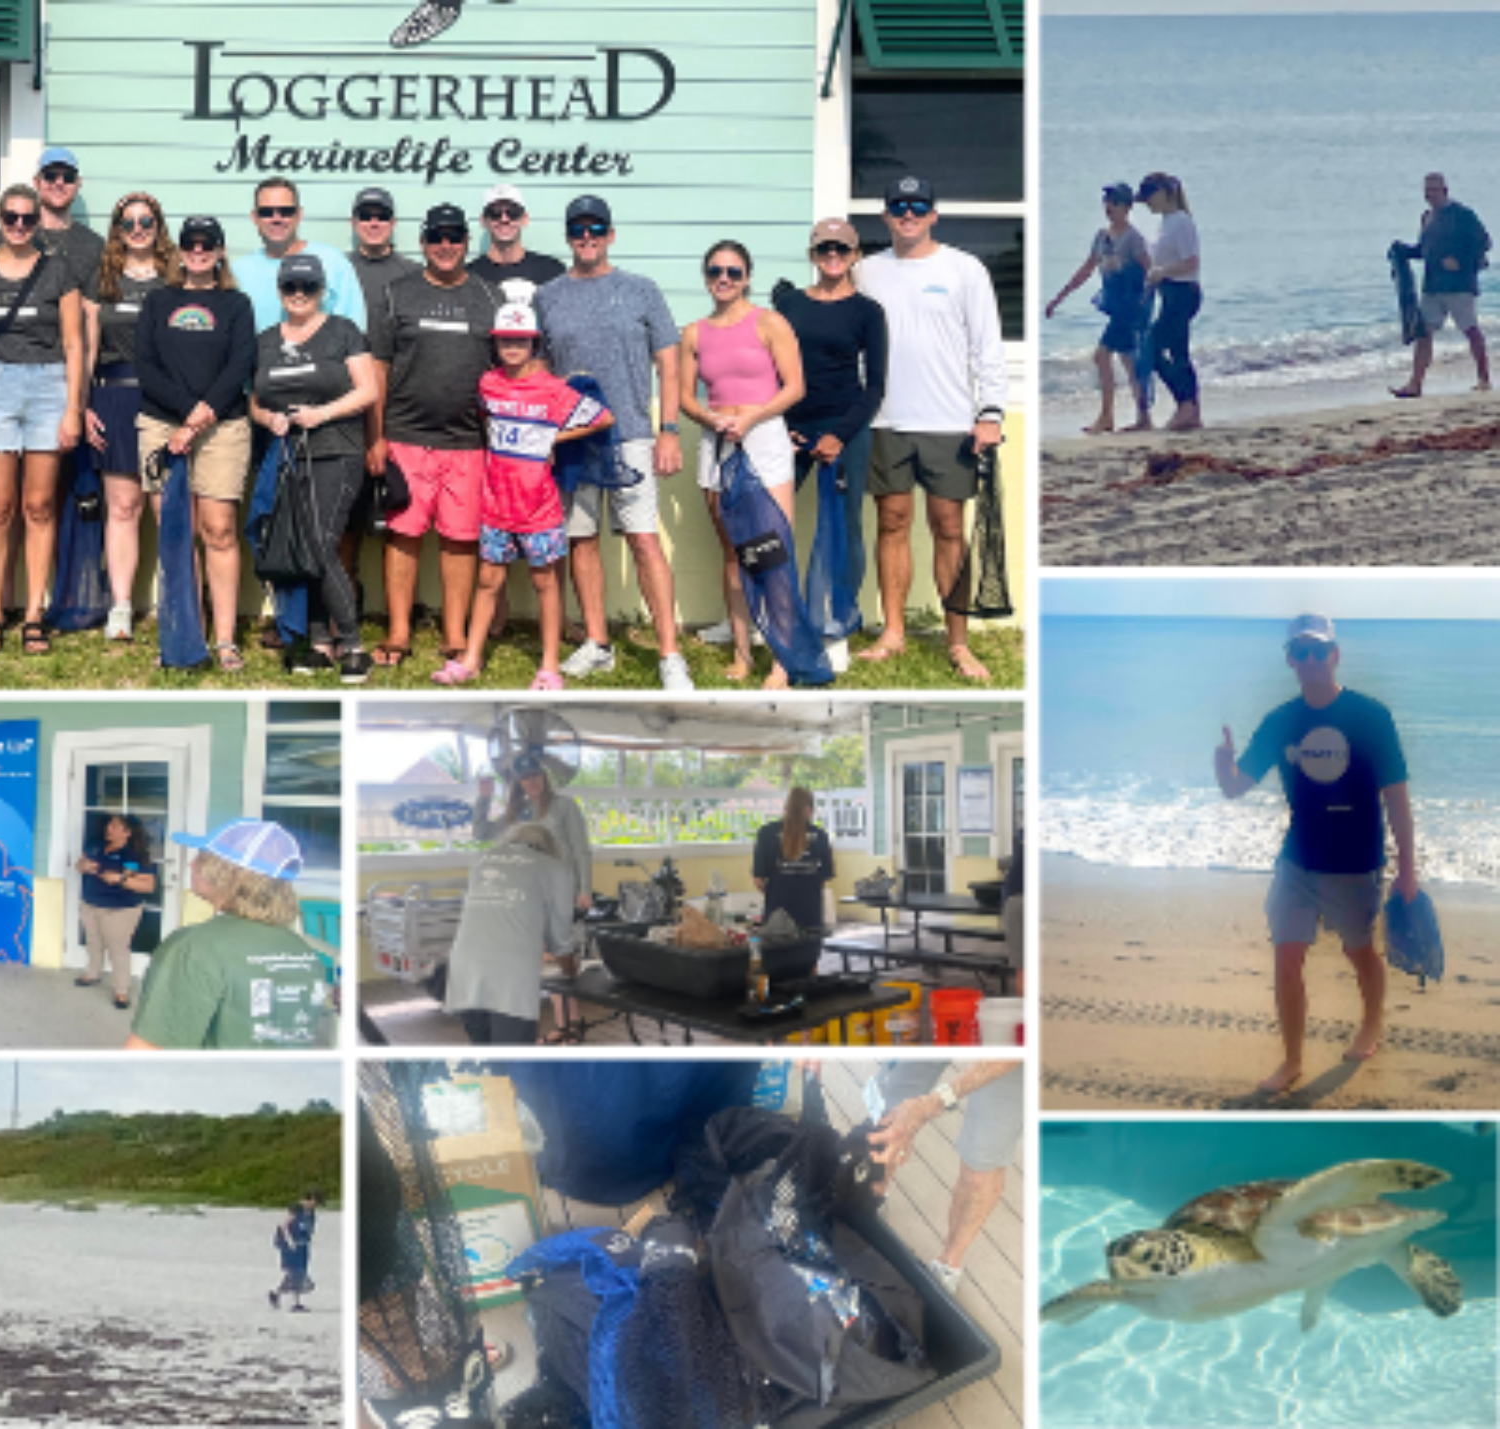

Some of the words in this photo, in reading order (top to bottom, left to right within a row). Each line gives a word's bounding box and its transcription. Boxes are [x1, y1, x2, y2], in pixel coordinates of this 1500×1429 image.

[182, 40, 676, 124] LOGGERHEAD
[215, 133, 473, 184] Marinelife
[487, 136, 634, 177] Center
